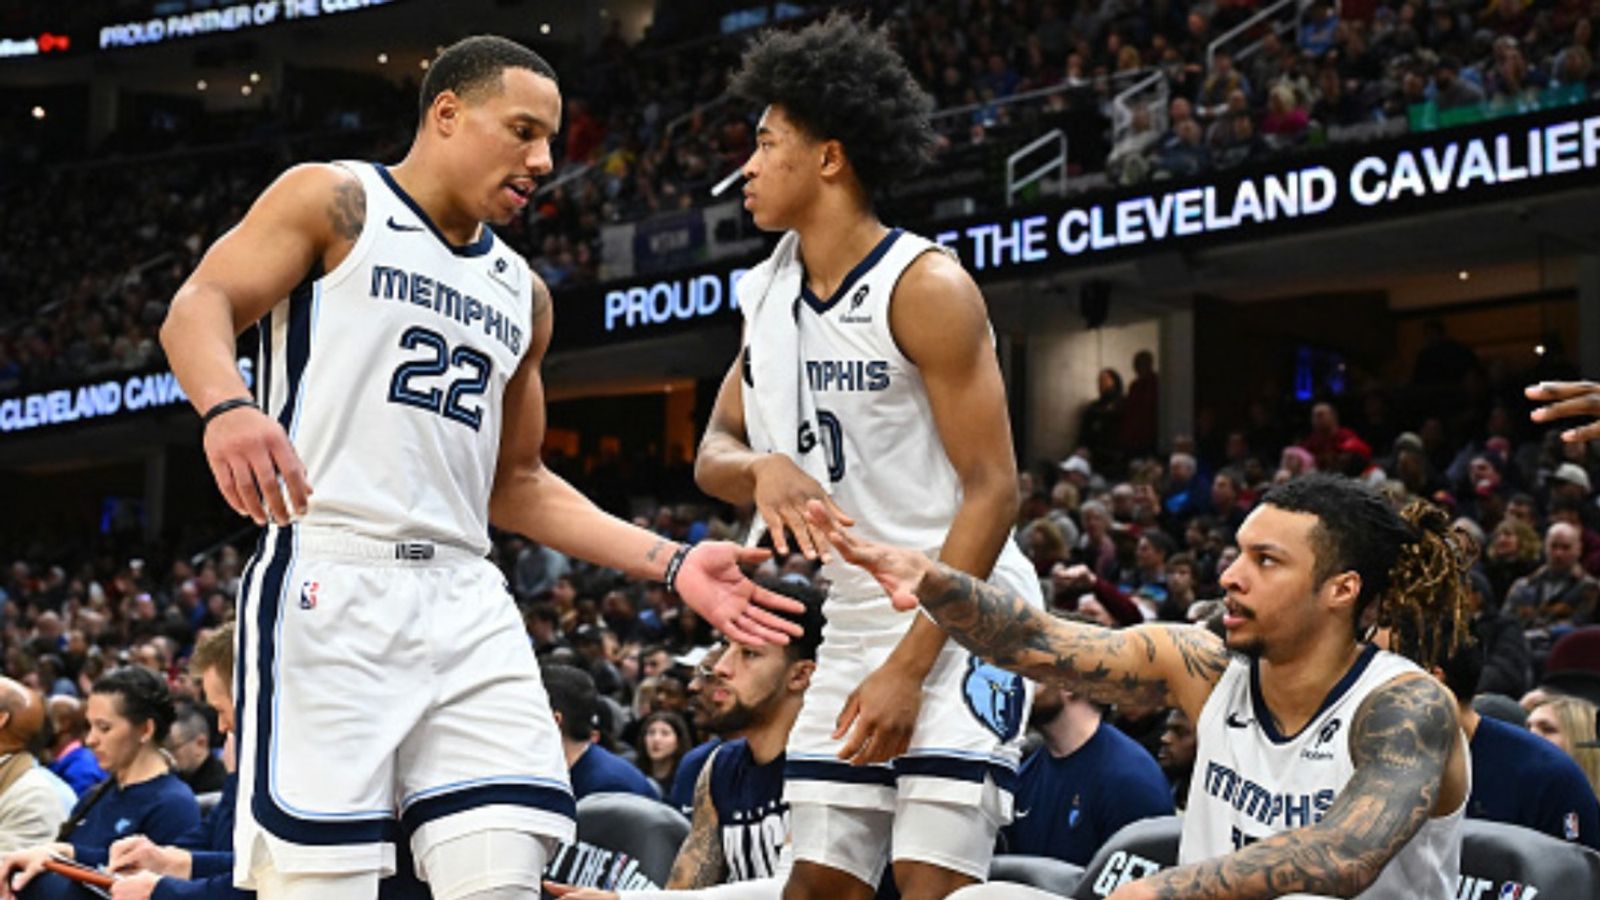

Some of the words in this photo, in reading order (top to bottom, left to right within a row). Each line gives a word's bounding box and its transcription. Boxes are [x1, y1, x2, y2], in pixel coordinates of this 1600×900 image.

[100, 21, 165, 49] PROUD
[166, 6, 251, 37] PARTNER
[253, 1, 279, 25] OF
[965, 214, 1048, 271] THE
[1056, 164, 1338, 255] CLEVELAND
[370, 265, 523, 356] MEMPHIS
[604, 274, 723, 332] PROUD
[0, 381, 121, 431] CLEVELAND
[386, 325, 494, 433] 22
